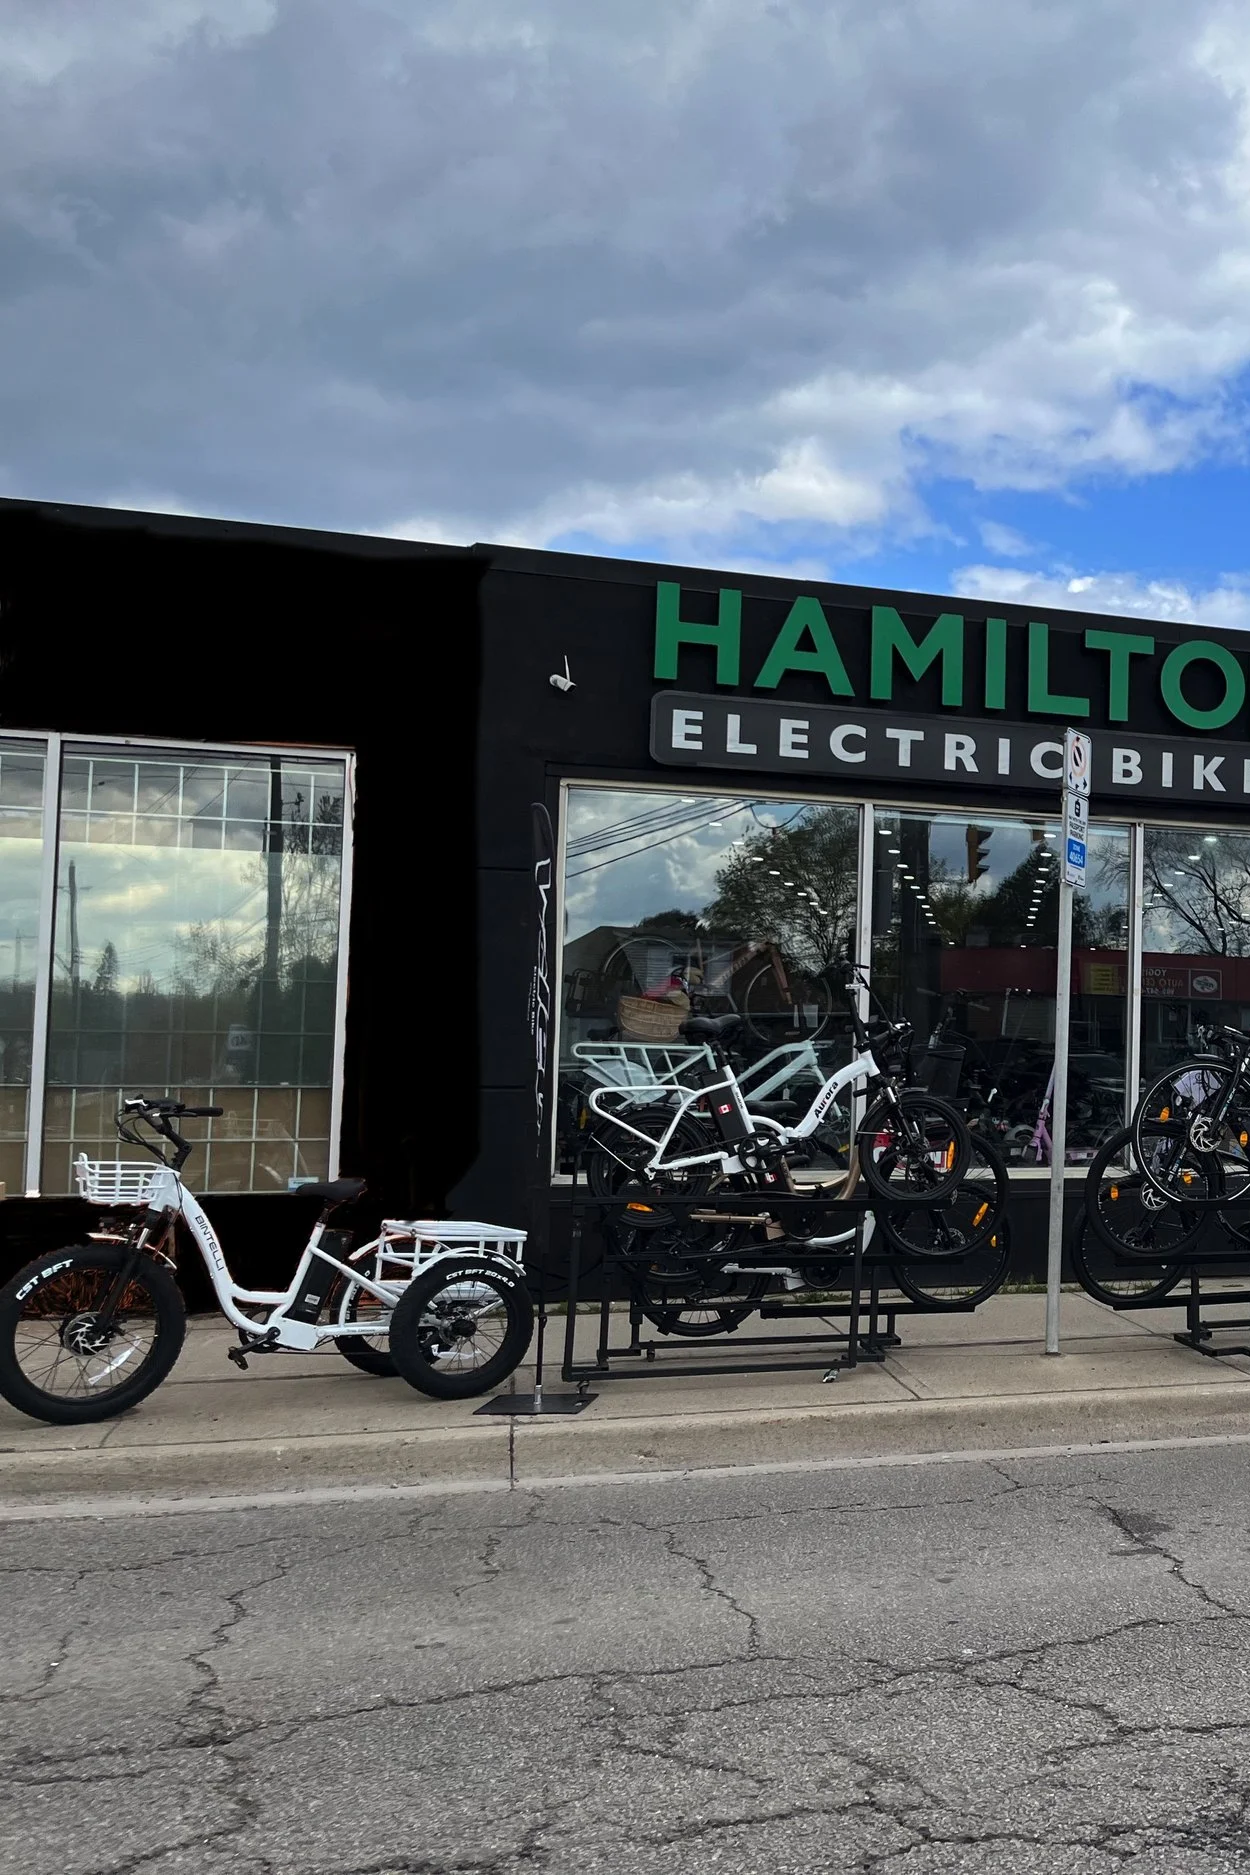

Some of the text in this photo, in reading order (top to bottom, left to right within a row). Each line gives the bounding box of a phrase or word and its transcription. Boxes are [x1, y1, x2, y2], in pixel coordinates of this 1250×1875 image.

[671, 709, 1063, 779] ELECTRIC
[813, 1081, 839, 1119] Aurora
[195, 1215, 224, 1271] BINTELLI
[15, 1259, 74, 1301] CST BFT
[446, 1270, 464, 1281] CST
